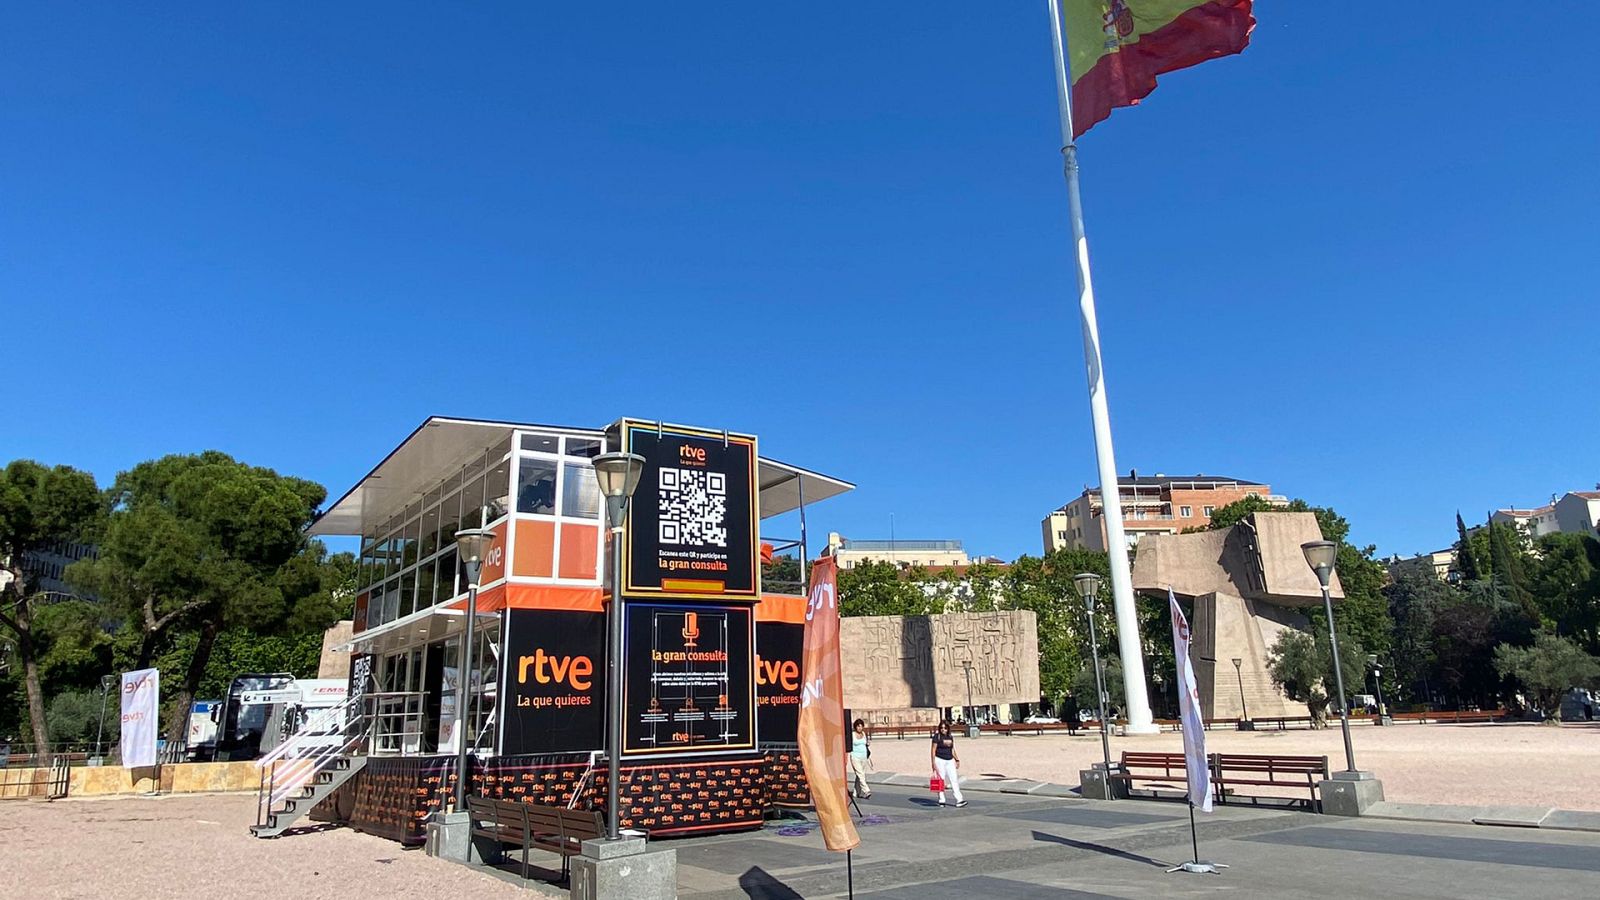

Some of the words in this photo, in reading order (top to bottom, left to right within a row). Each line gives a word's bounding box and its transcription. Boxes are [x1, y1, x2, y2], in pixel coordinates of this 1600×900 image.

[680, 444, 706, 461] rtve
[658, 558, 668, 568] la
[669, 560, 690, 570] gran
[690, 560, 728, 570] consulta
[652, 650, 663, 661] la
[664, 652, 686, 663] gran
[688, 650, 727, 662] consulta
[518, 648, 593, 690] rtve
[755, 654, 799, 690] tve
[517, 694, 530, 706] La
[533, 696, 552, 708] que
[555, 694, 591, 708] quieres
[770, 694, 799, 706] quieres
[672, 732, 689, 742] rtve
